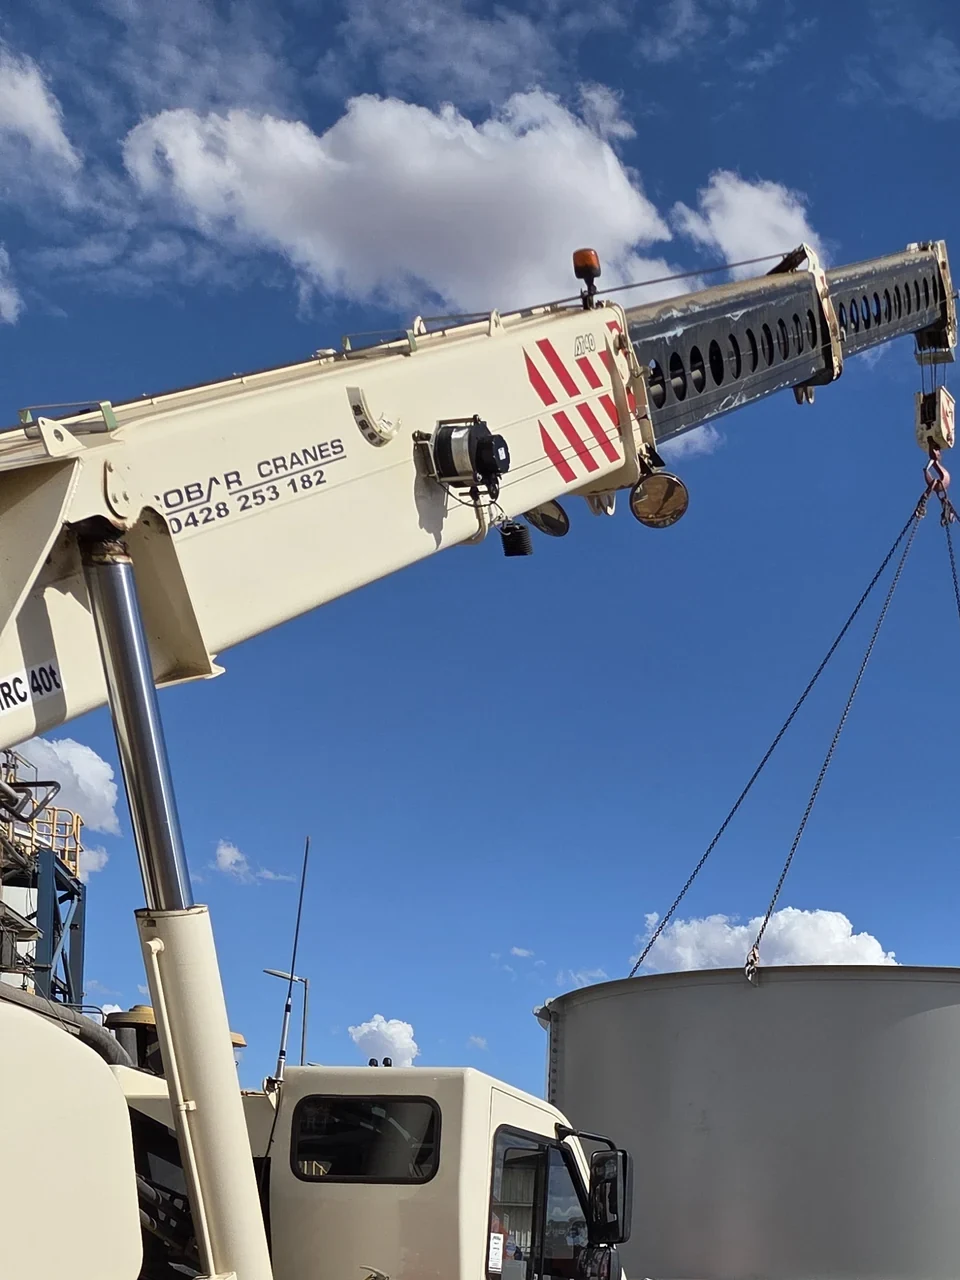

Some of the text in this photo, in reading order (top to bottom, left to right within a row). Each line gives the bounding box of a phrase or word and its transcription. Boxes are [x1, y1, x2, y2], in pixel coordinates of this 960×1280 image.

[154, 438, 345, 509] OBAR CRANES
[169, 469, 327, 534] 0428 253 182
[0, 664, 61, 711] RC 40t
